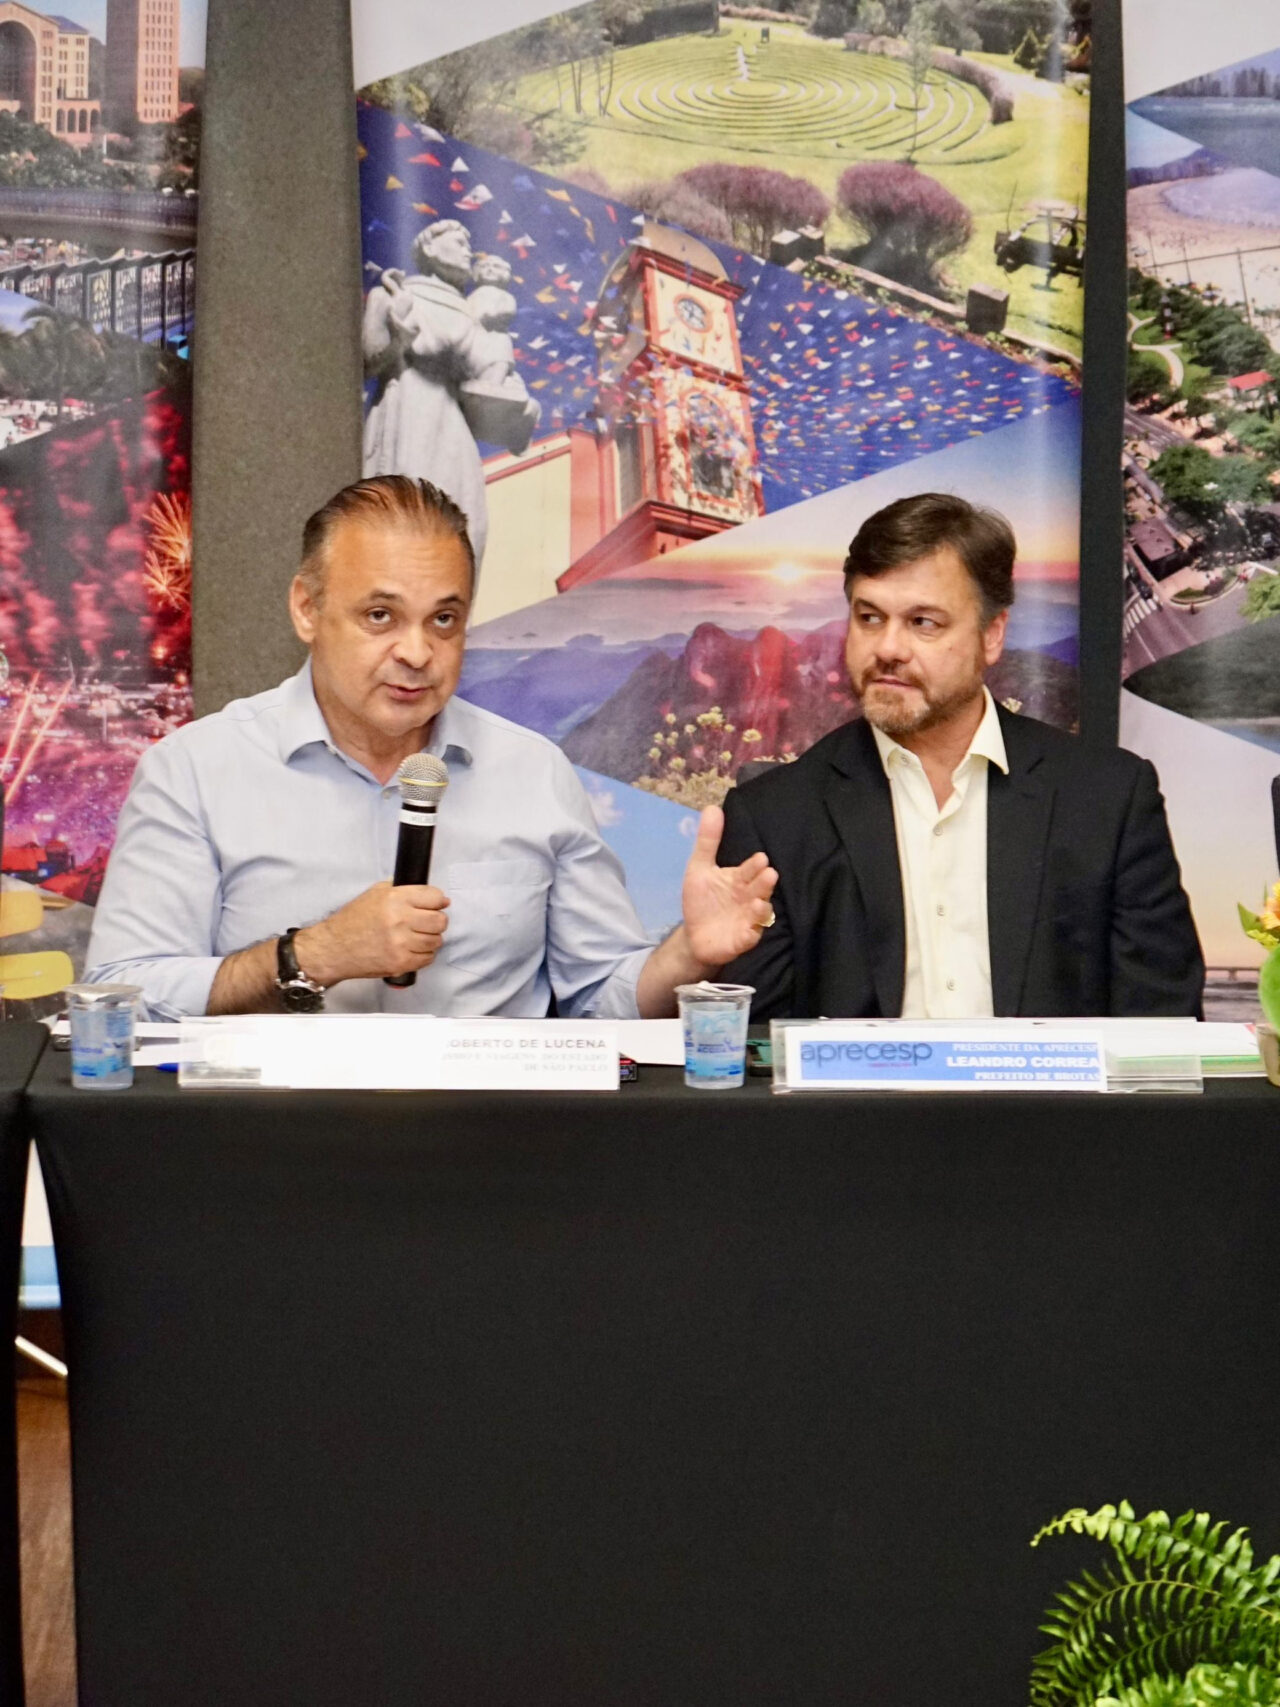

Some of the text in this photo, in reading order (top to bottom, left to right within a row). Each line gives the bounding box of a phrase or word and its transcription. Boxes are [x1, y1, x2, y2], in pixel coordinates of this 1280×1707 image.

[446, 1038, 607, 1049] OBERTO DE LUCENA
[952, 1043, 1021, 1052] PRESIDENTE
[1023, 1043, 1040, 1052] DA
[801, 1042, 933, 1068] aprecesp
[946, 1056, 1099, 1068] LEANDRO CORREA
[974, 1072, 1034, 1081] PREFEITO
[1037, 1072, 1049, 1081] DE
